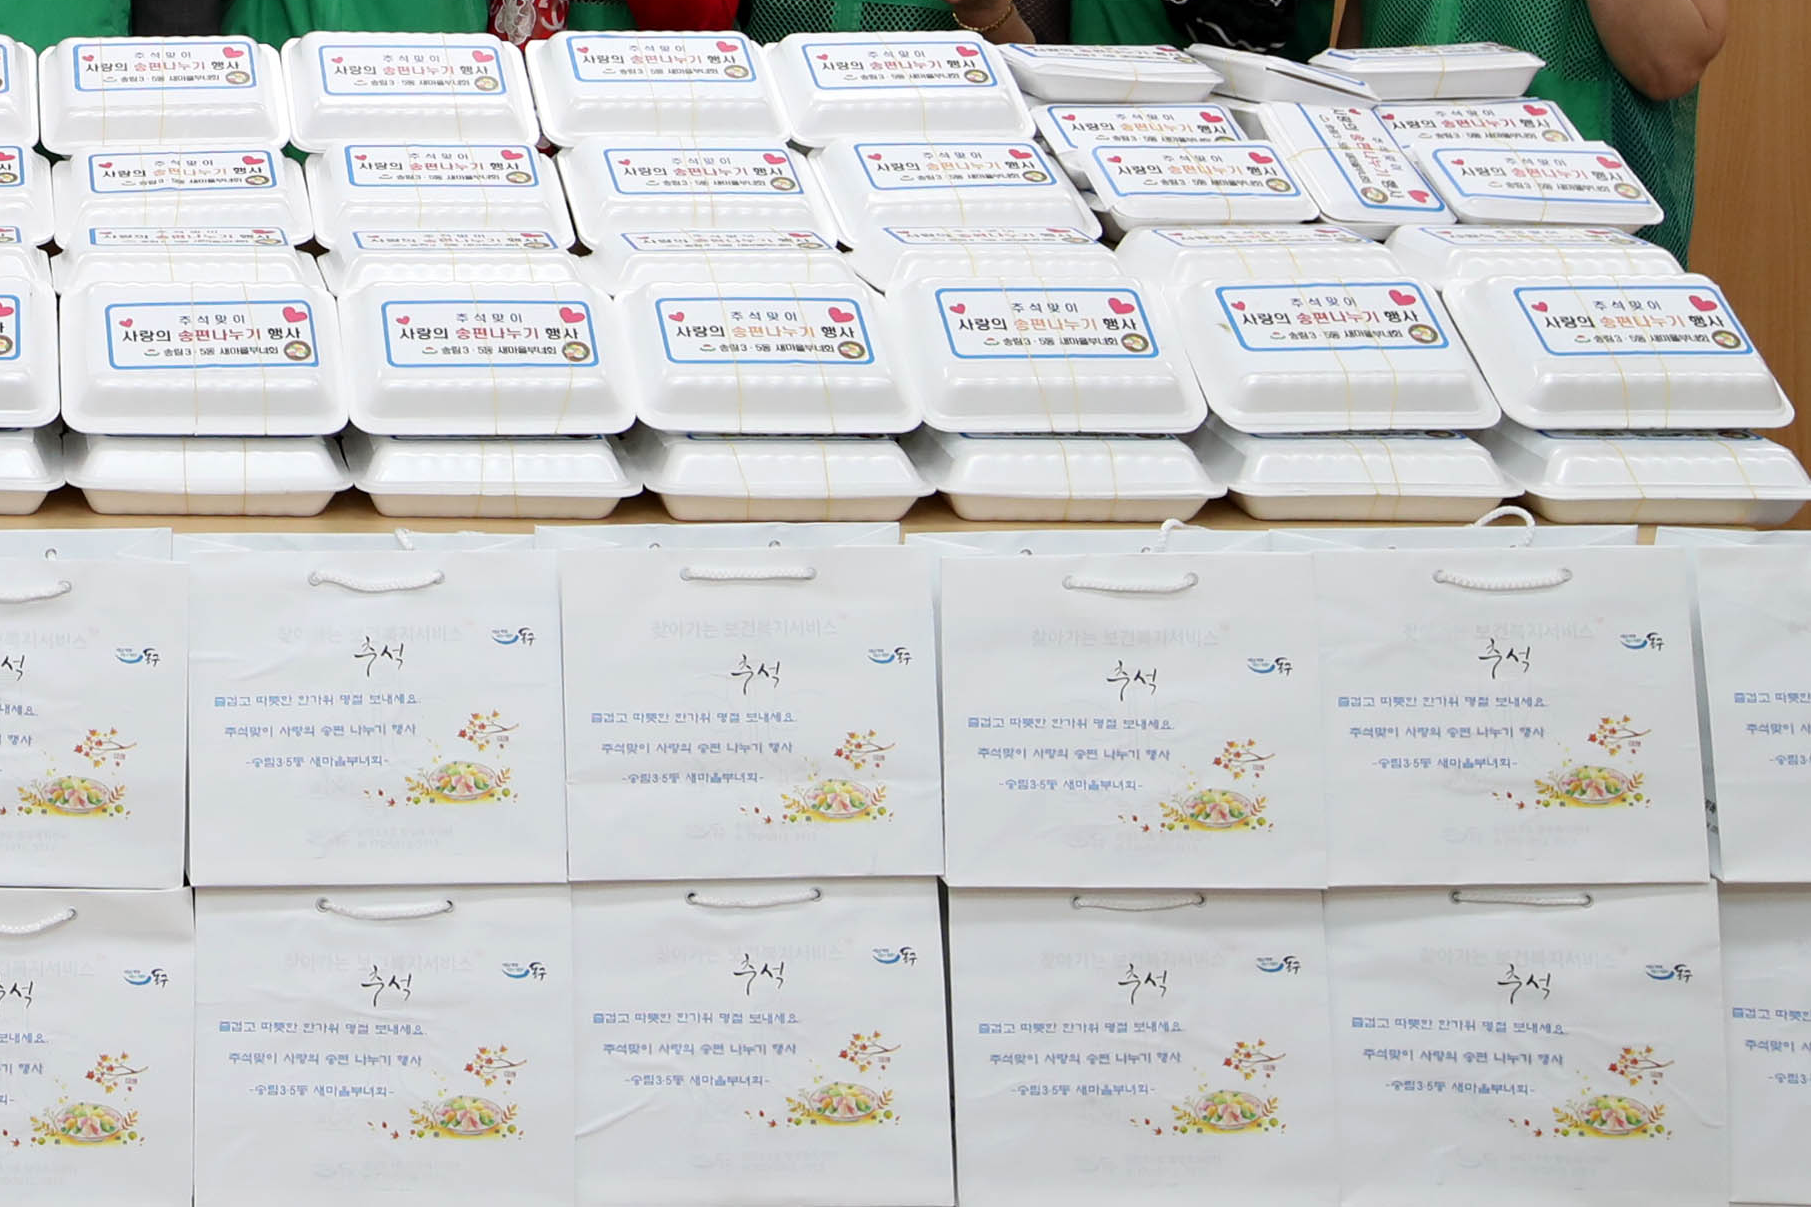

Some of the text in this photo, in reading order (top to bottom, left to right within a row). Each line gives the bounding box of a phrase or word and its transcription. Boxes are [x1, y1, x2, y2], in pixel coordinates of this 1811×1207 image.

[123, 327, 300, 342] 사랑의 송편나누기 행사
[400, 326, 578, 342] 사랑의 송편나누기 행사
[676, 324, 853, 340] 사랑의 송편나누기 행사
[957, 316, 1136, 332] 사랑의 송편나누기 행사
[1241, 310, 1421, 325] 사랑의 송편나누기 행사
[1542, 314, 1724, 329] 사랑의 송편나누기 행사
[353, 635, 404, 677] 추석
[730, 653, 781, 695] 추석
[1478, 638, 1531, 679] 추석
[1106, 660, 1158, 702] 추석
[361, 965, 412, 1007] 추석
[733, 953, 785, 995] 추석
[1116, 962, 1169, 1005] 추석
[1497, 963, 1551, 1006] 추석
